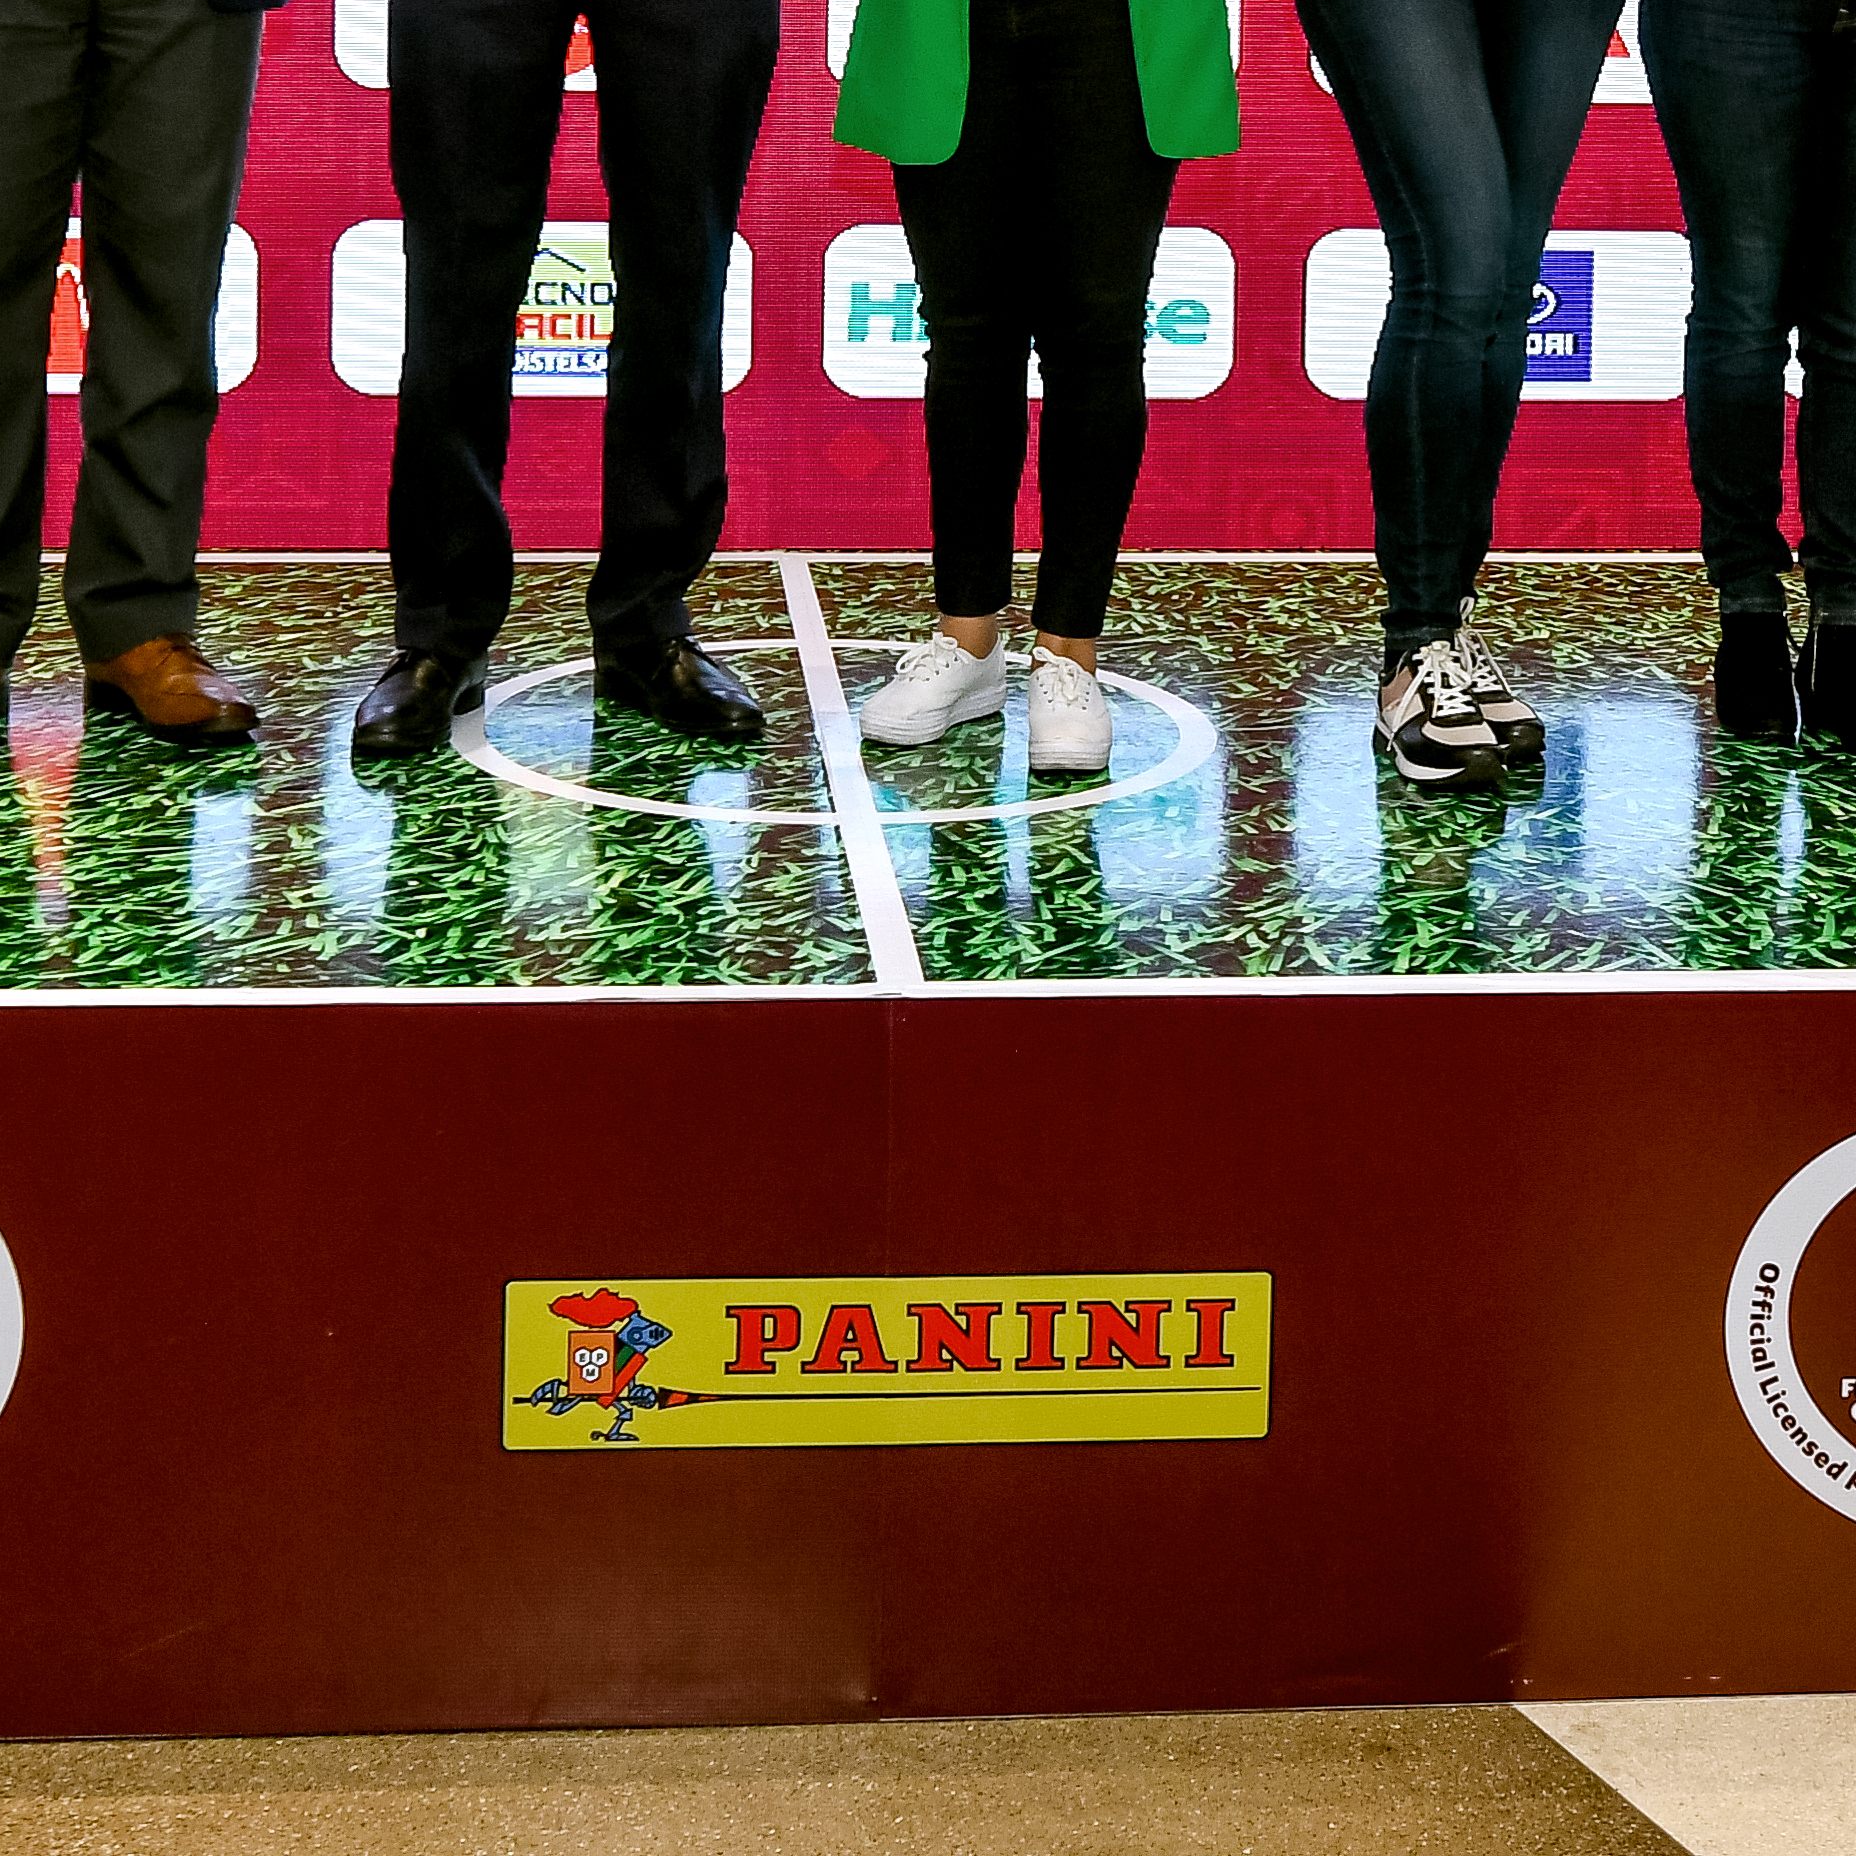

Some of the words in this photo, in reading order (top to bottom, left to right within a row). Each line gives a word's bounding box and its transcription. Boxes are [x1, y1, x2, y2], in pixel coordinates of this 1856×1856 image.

[515, 313, 613, 340] ACIL
[724, 1297, 1237, 1377] PANINI
[1749, 1261, 1781, 1373] Official
[1758, 1374, 1848, 1482] Licensed
